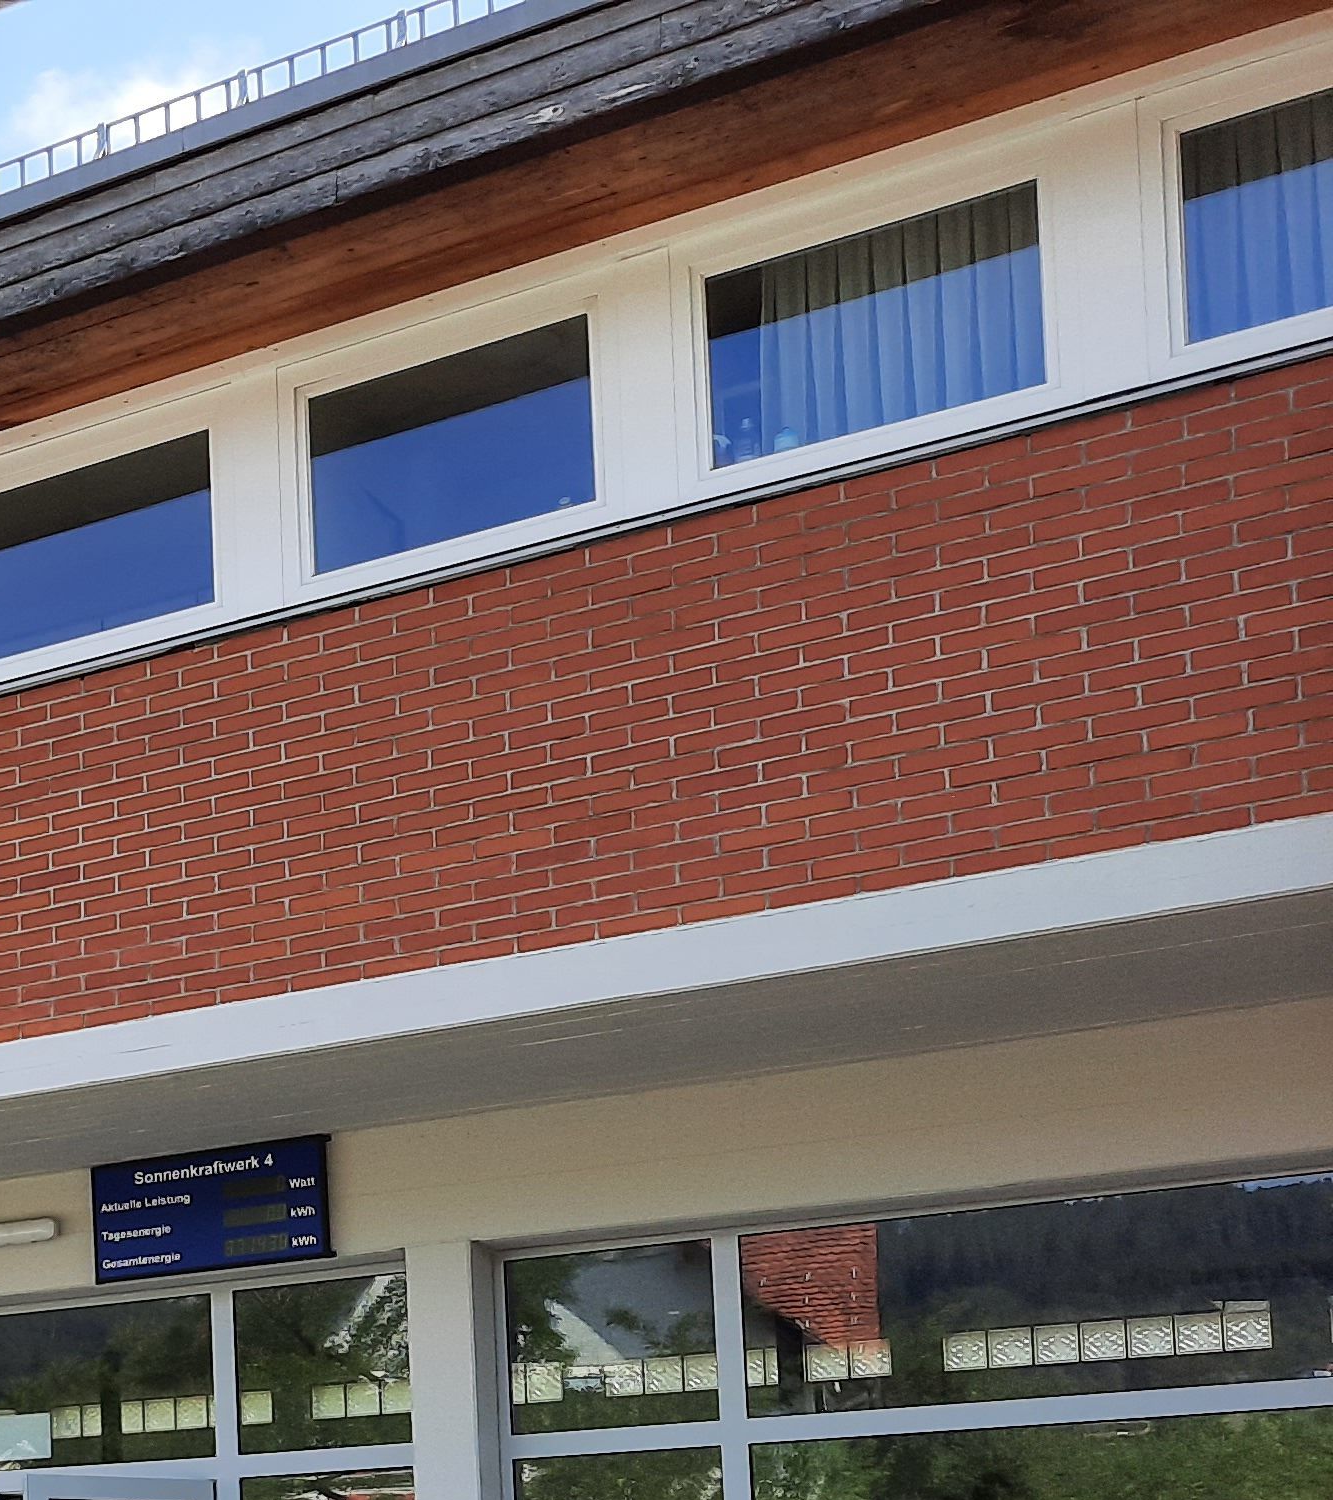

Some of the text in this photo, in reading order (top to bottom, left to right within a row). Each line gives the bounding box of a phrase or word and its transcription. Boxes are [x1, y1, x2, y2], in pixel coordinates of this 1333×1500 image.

[133, 1155, 260, 1186] Sonnenkraftwerk
[263, 1153, 274, 1167] 4
[288, 1176, 316, 1189] Watt
[100, 1193, 191, 1214] Aktuelle Leistung
[290, 1205, 316, 1218] kWh
[101, 1224, 172, 1242] Tagesenergie
[291, 1235, 317, 1247] kWh
[102, 1252, 181, 1270] Gesamtenergie
